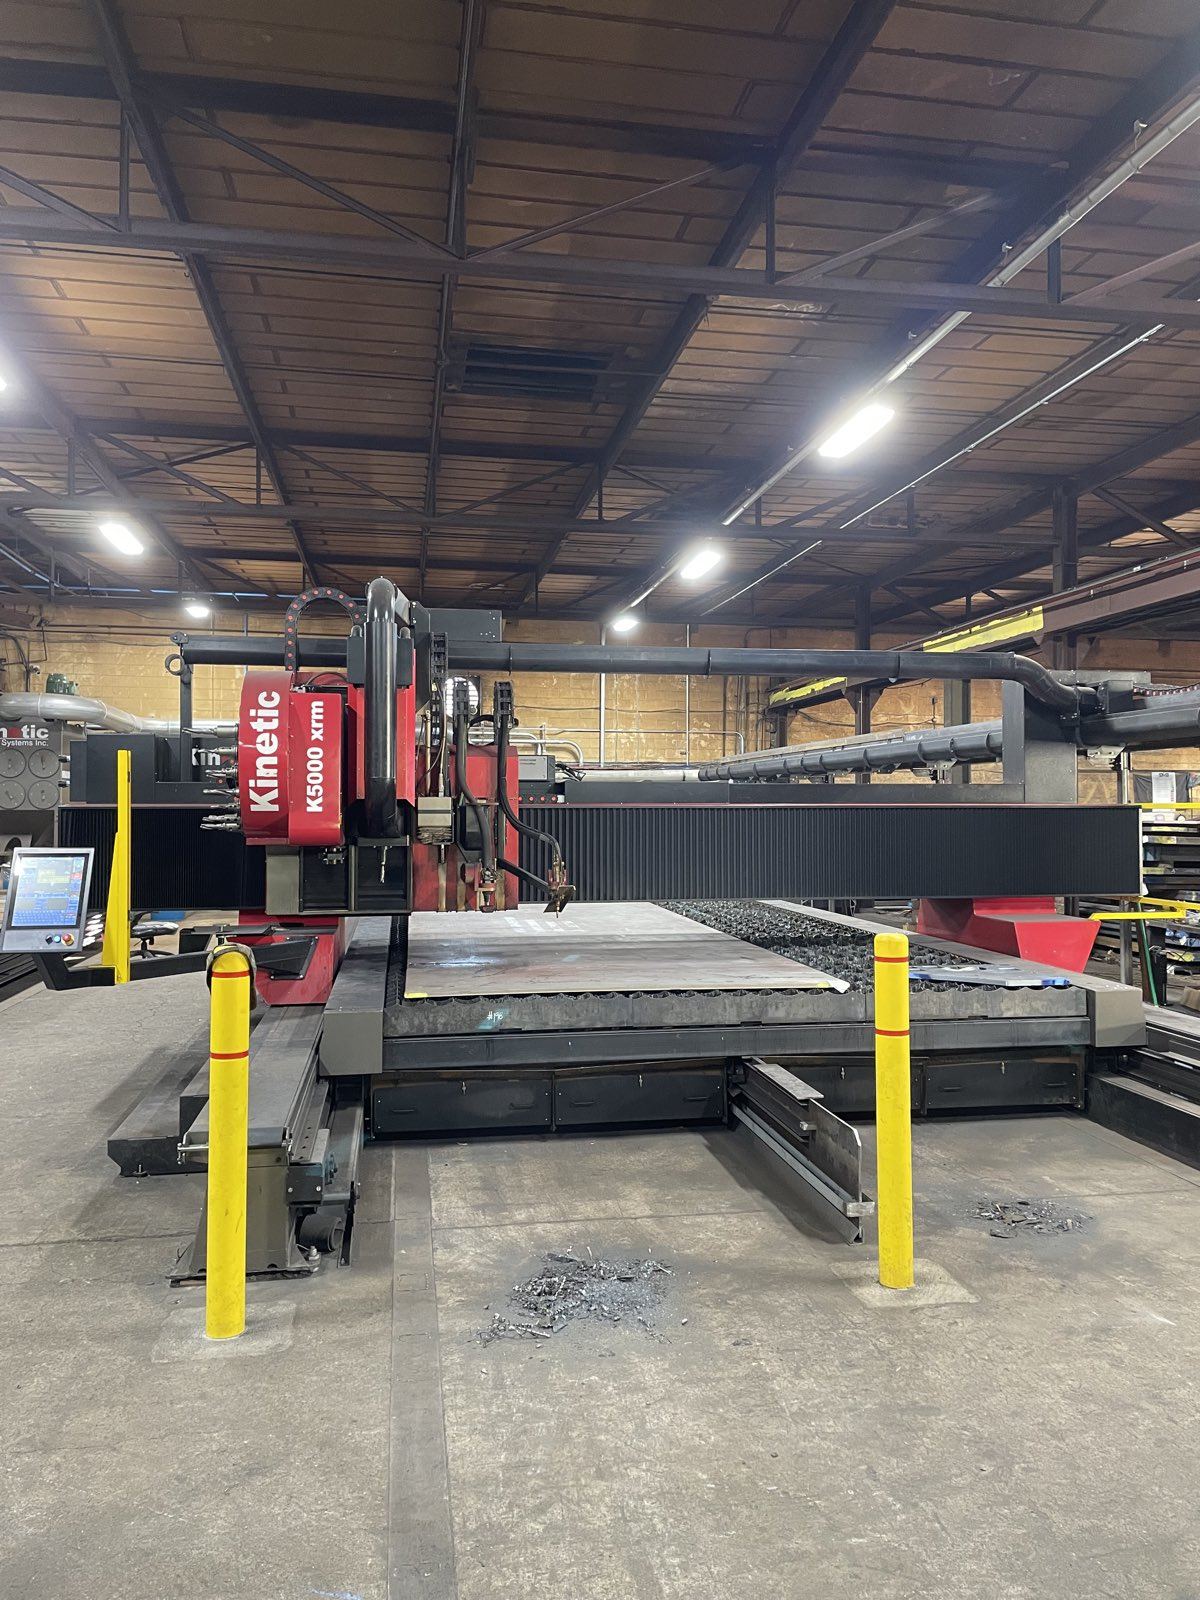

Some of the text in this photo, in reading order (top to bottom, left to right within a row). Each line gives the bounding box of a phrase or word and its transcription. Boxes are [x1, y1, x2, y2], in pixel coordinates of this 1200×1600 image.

[0, 724, 49, 739] ntic
[1, 739, 33, 747] Systems
[248, 690, 281, 812] Kinetic
[192, 748, 221, 766] Kin
[306, 700, 324, 813] K5000 xrm
